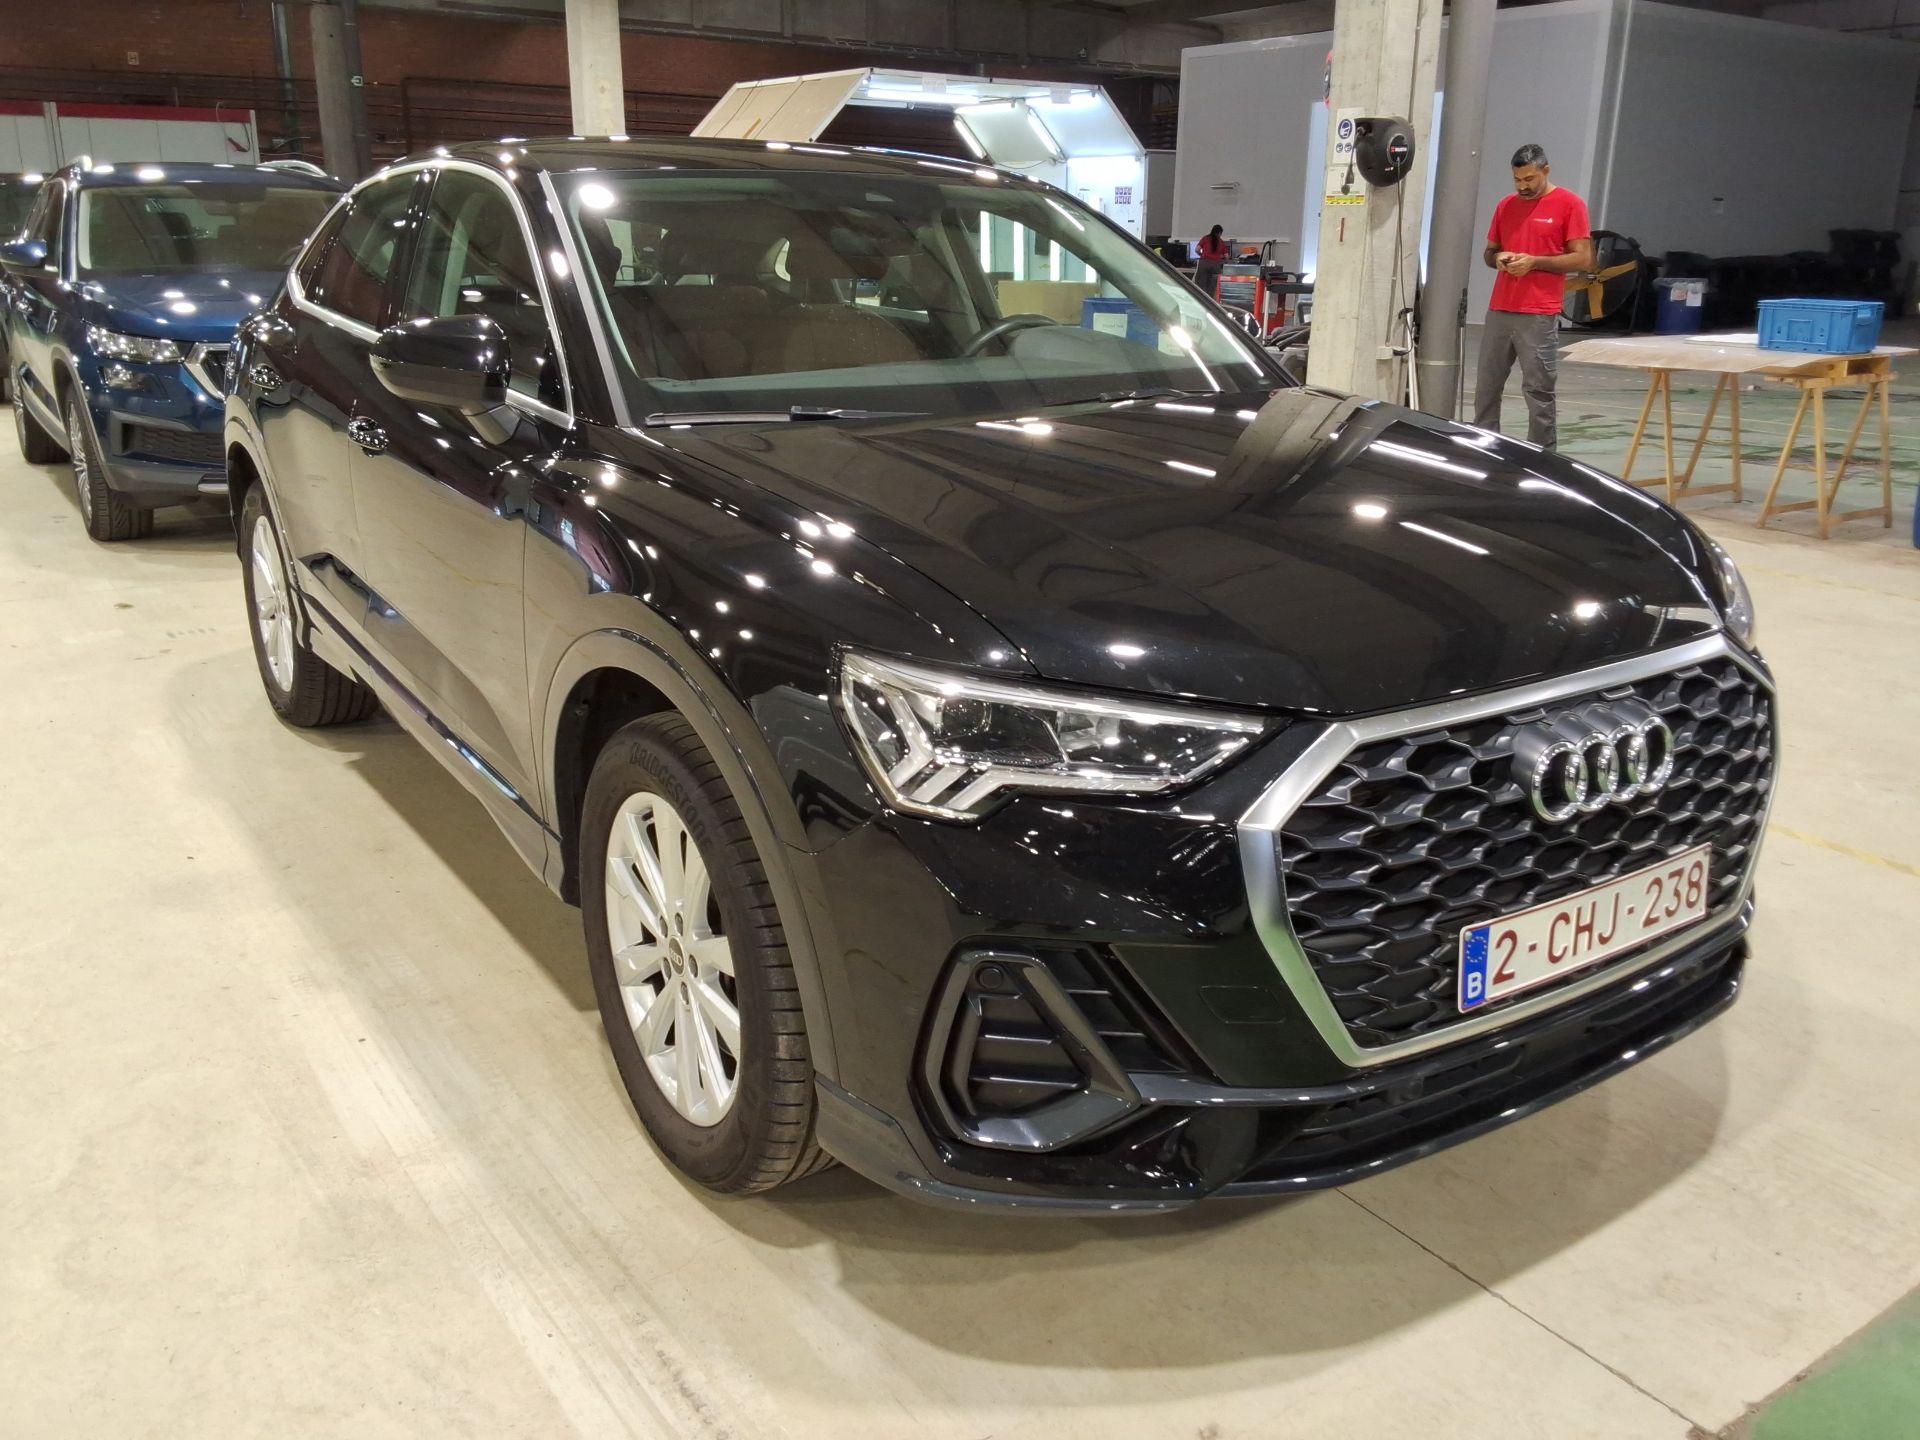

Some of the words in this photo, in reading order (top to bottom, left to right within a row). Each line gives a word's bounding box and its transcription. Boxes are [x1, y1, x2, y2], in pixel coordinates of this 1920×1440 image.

[629, 742, 712, 855] BRIDGESTONE
[1492, 860, 1704, 985] 2-CHJ-238
[1467, 971, 1482, 998] B
